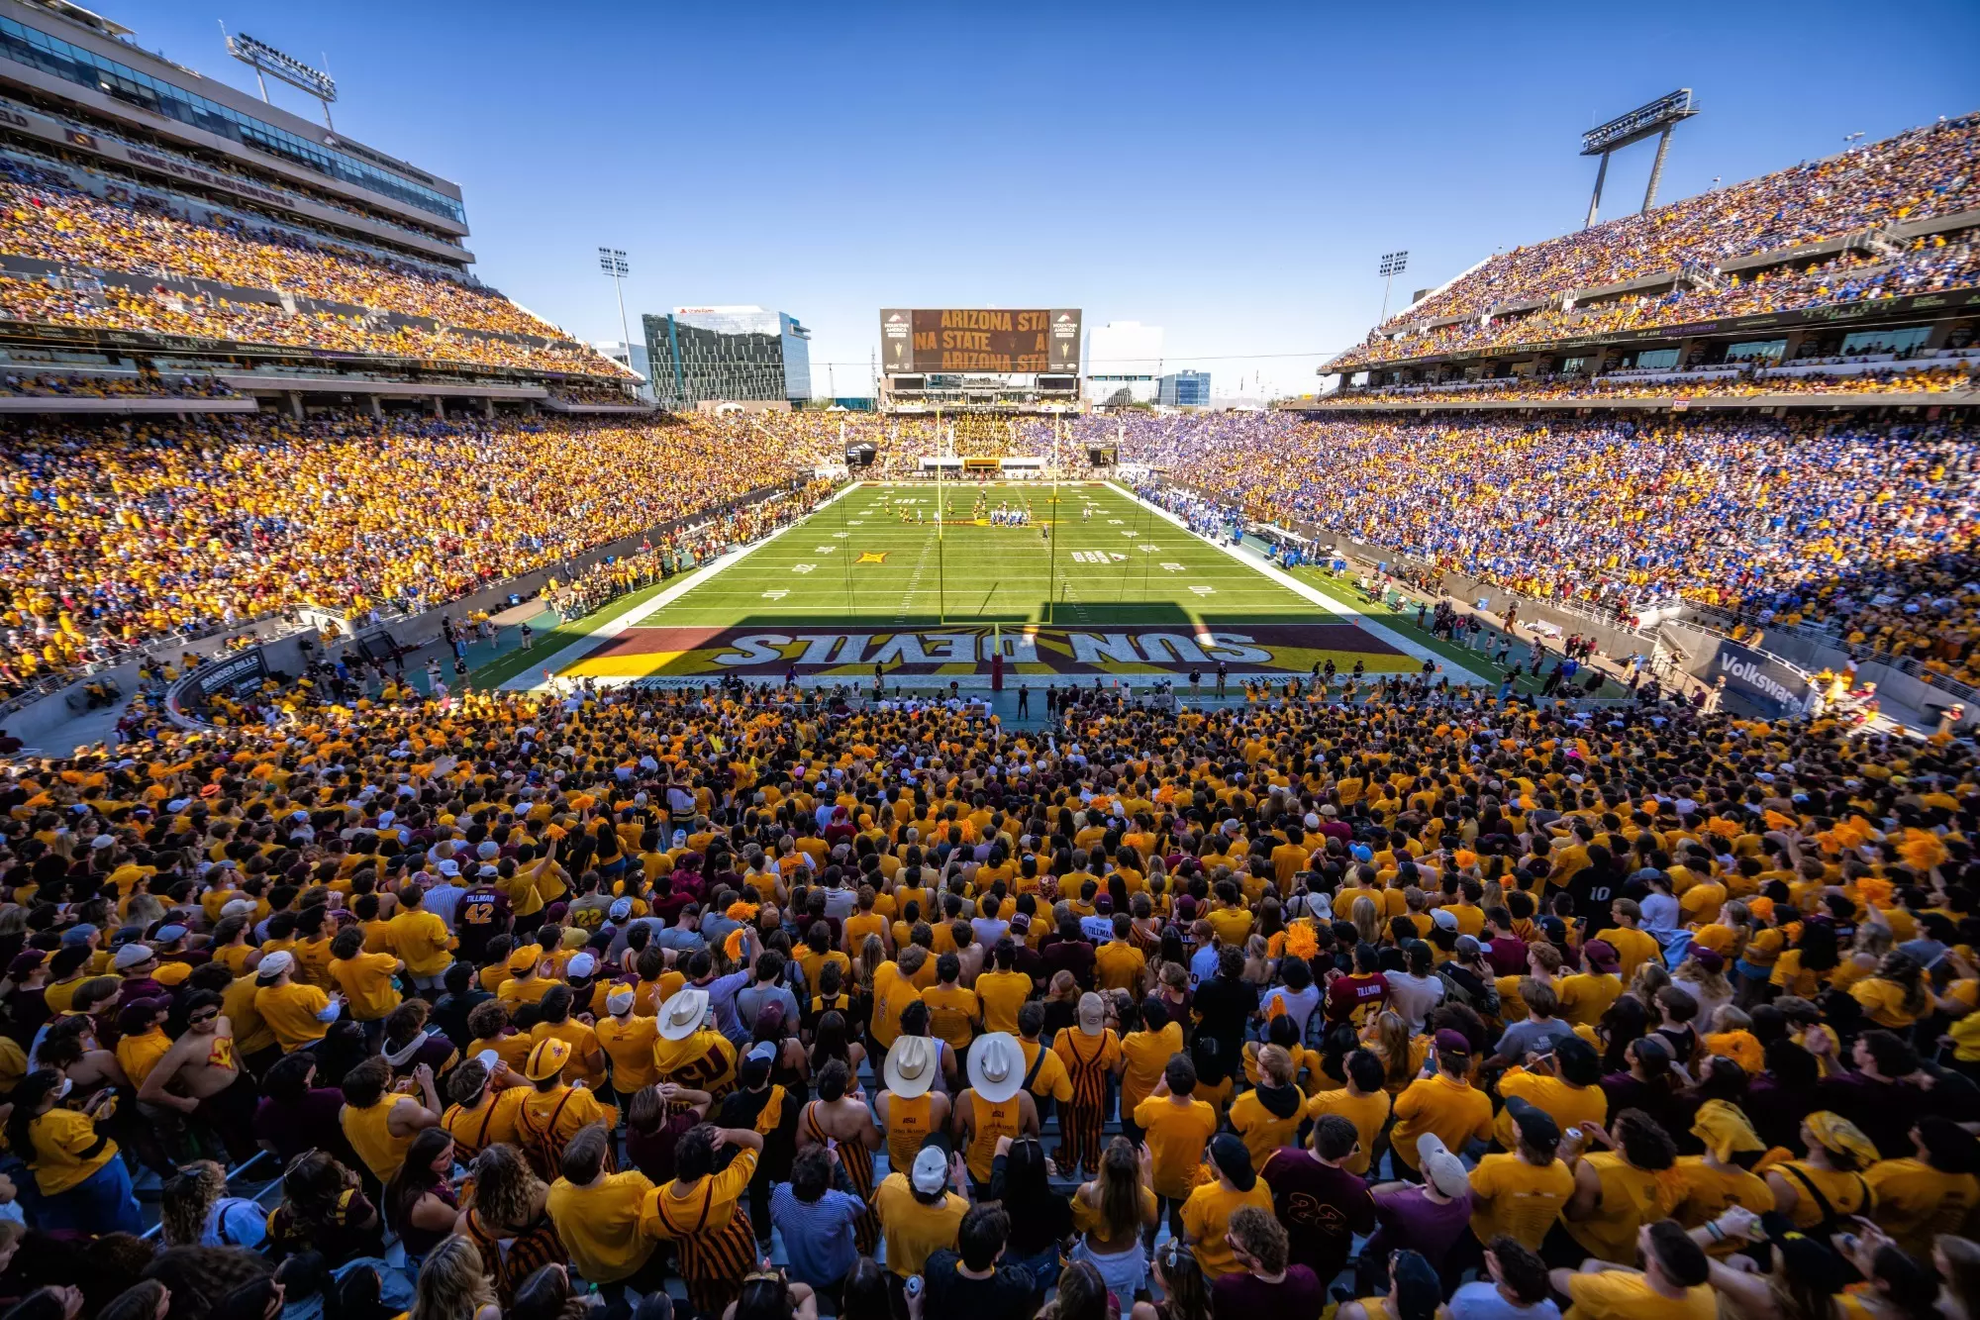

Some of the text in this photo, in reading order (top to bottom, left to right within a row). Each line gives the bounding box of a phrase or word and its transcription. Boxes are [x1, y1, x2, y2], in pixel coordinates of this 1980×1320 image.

[128, 149, 295, 208] HOME OF THE ASU SUN DEVILS
[941, 310, 1050, 332] ARIZONA STA
[1662, 327, 1683, 335] EXACT
[1683, 324, 1717, 333] SCIENCES
[912, 332, 937, 350] NA
[942, 331, 991, 351] STATE
[942, 352, 1049, 372] ARIZONA STA
[712, 633, 1275, 665] SUN DEVILS
[201, 665, 235, 689] BRANDED
[234, 655, 259, 671] BILLS
[466, 895, 496, 903] TILLMAN
[1590, 886, 1611, 902] 10
[465, 904, 494, 924] 42
[575, 908, 603, 928] 22
[1088, 926, 1114, 939] TILLMAN
[1356, 984, 1381, 998] TILLMAN
[1349, 1000, 1383, 1028] 42
[1288, 1191, 1347, 1237] 22
